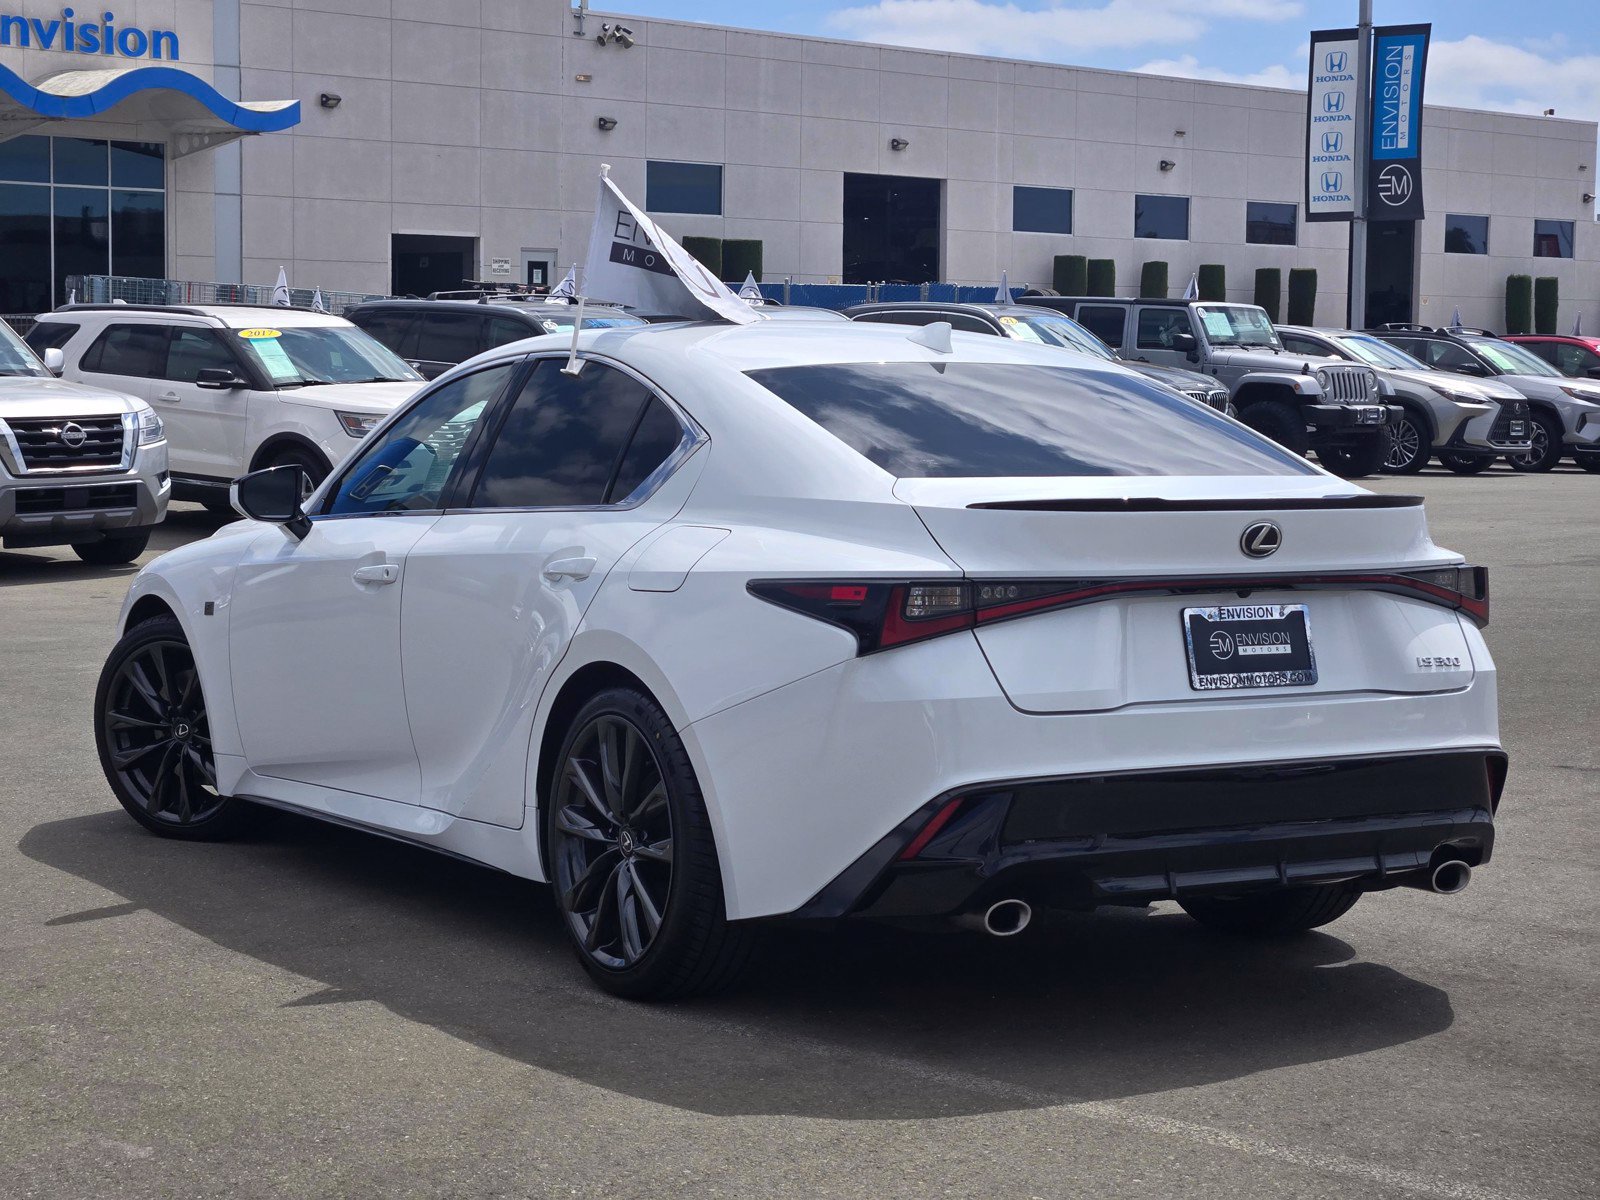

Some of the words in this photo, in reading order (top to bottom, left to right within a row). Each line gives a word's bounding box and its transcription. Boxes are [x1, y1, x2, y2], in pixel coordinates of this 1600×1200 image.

[1315, 74, 1355, 83] HONDA
[1381, 45, 1402, 150] ENVISION
[1399, 54, 1412, 140] MOTORS
[1313, 114, 1352, 123] HONDA
[1312, 154, 1351, 163] HONDA
[1312, 194, 1352, 202] HONDA
[1219, 606, 1274, 620] ENVISION
[1235, 631, 1291, 646] ENVISION
[1198, 671, 1313, 688] ENVISIONMOTORS.COM
